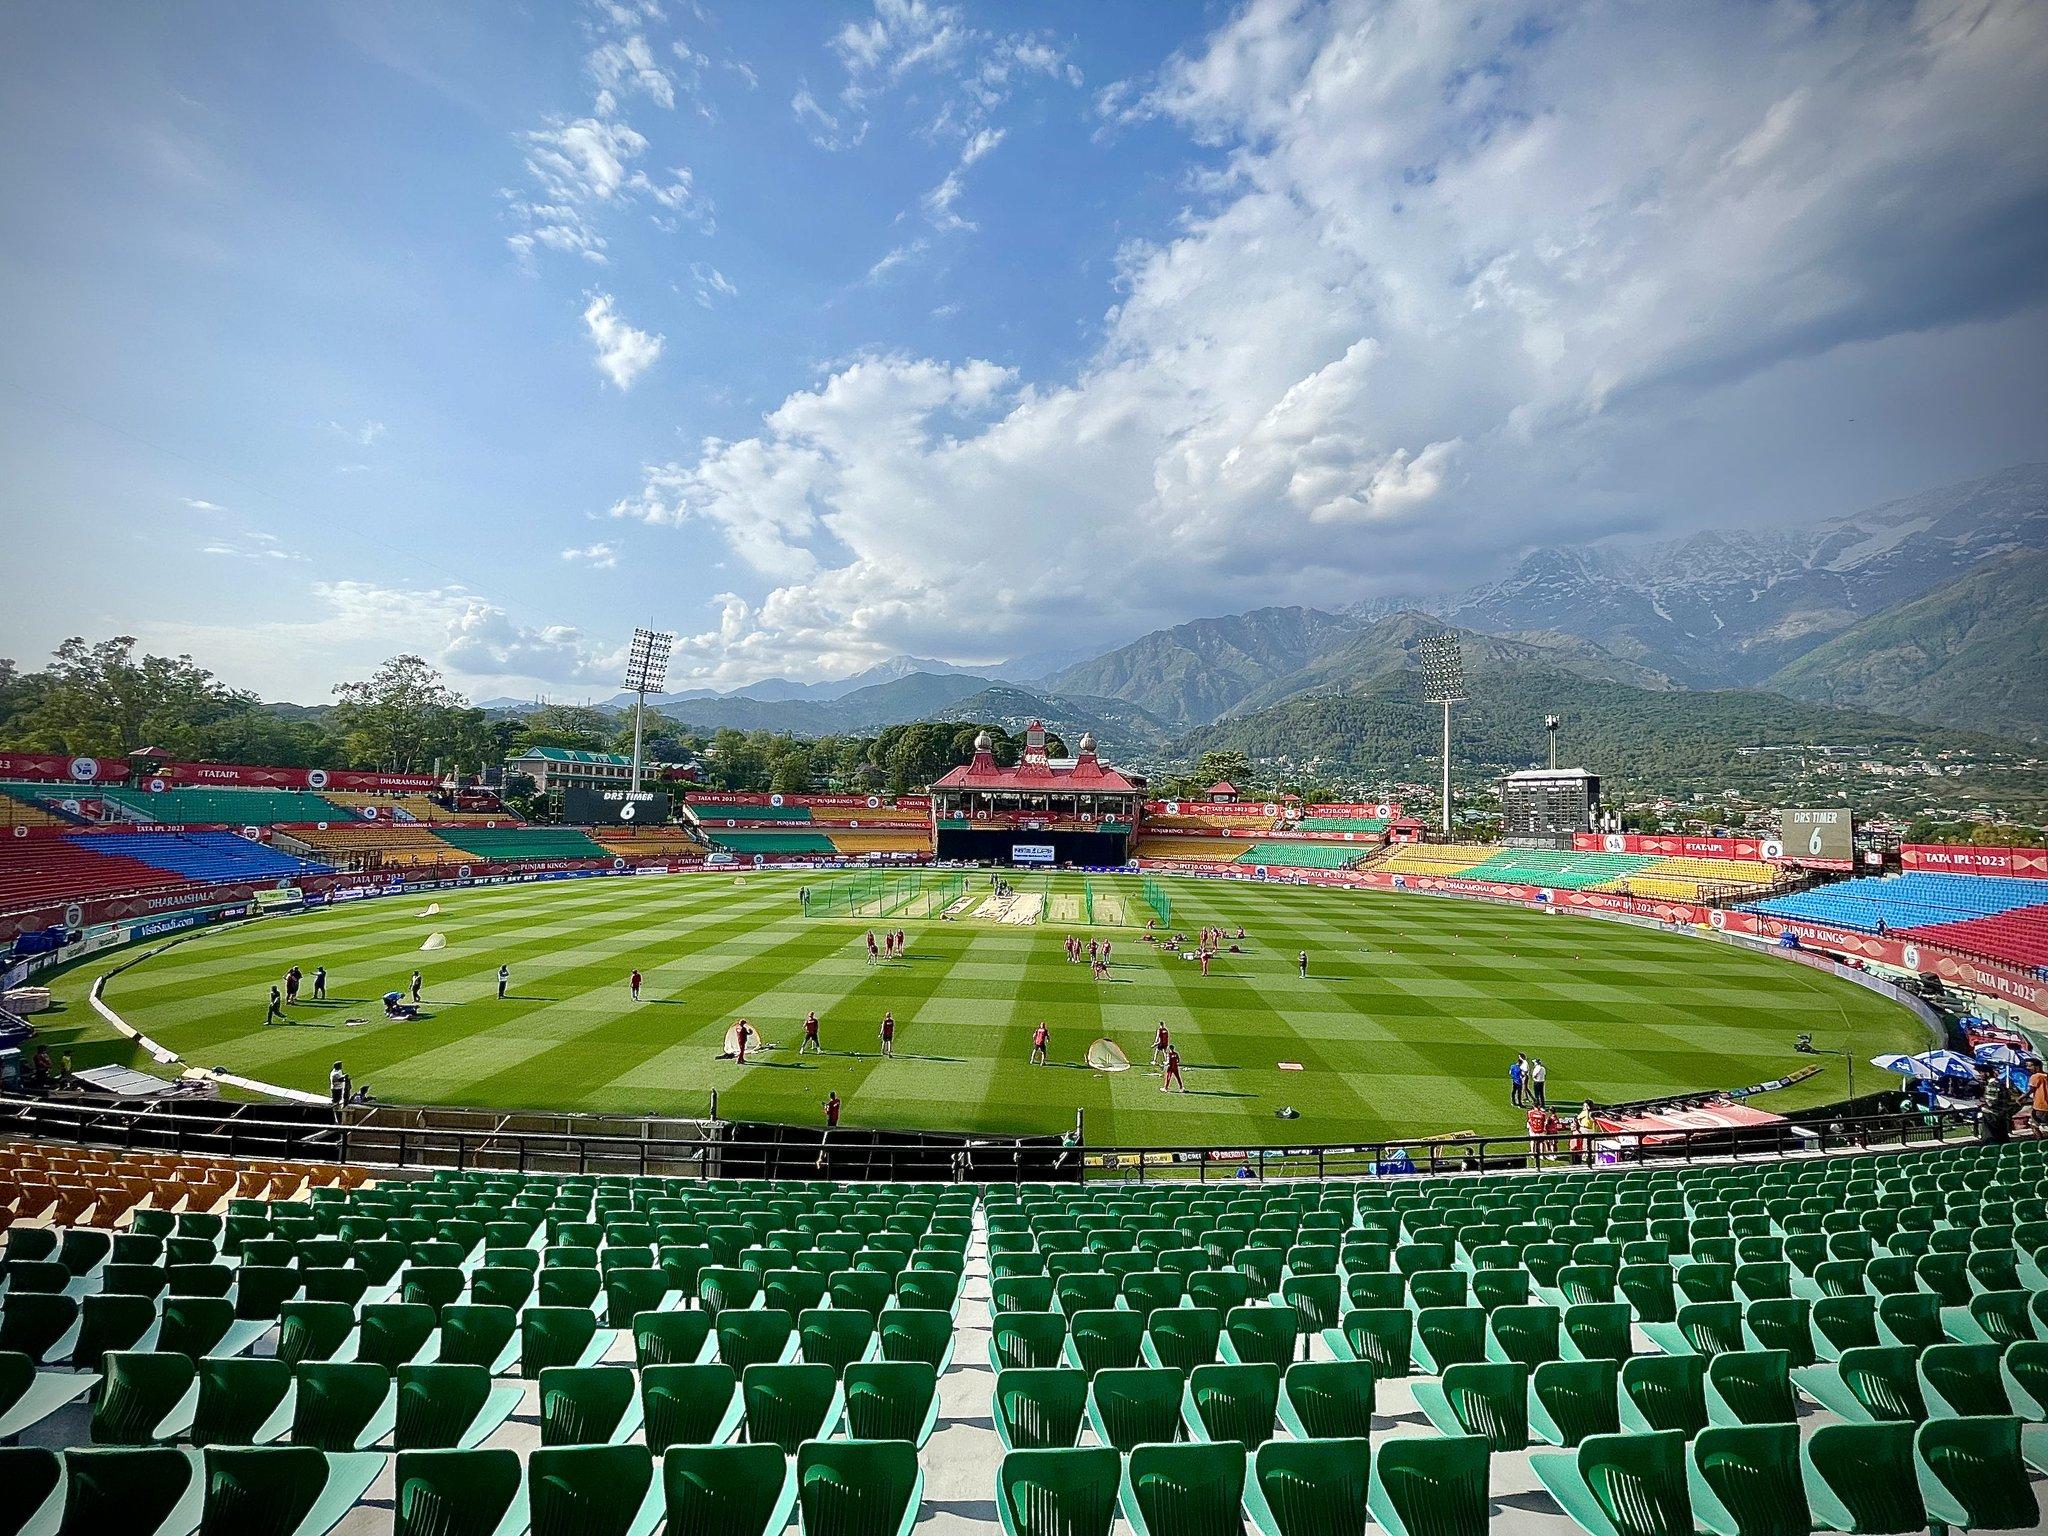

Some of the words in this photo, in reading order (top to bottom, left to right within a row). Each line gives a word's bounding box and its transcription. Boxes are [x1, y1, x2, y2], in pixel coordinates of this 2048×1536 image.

[198, 770, 241, 779] #TATAIPL
[380, 777, 434, 786] DHARAMSHALA
[603, 792, 624, 801] DRS
[626, 793, 654, 801] TIMER
[620, 801, 635, 820] 6
[1794, 811, 1811, 823] DRS
[1812, 811, 1838, 824] TIMER
[1808, 826, 1822, 856] 6
[1924, 852, 1952, 864] TATA
[1954, 854, 1971, 865] IPL
[1974, 855, 2006, 867] 2023
[520, 863, 545, 871] PUNJAB
[547, 861, 568, 869] KINGS
[352, 876, 371, 884] TATA
[373, 874, 384, 882] IPL
[1447, 882, 1494, 893] DHARAMSHALA
[148, 892, 215, 909] DHARAMSHALA
[1604, 899, 1621, 907] TATA
[1782, 923, 1815, 939] PUNJAB
[1816, 930, 1844, 944] KINGS
[1976, 971, 1996, 988] TATA
[1997, 977, 2011, 994] IPL
[2012, 982, 2036, 1000] 2023
